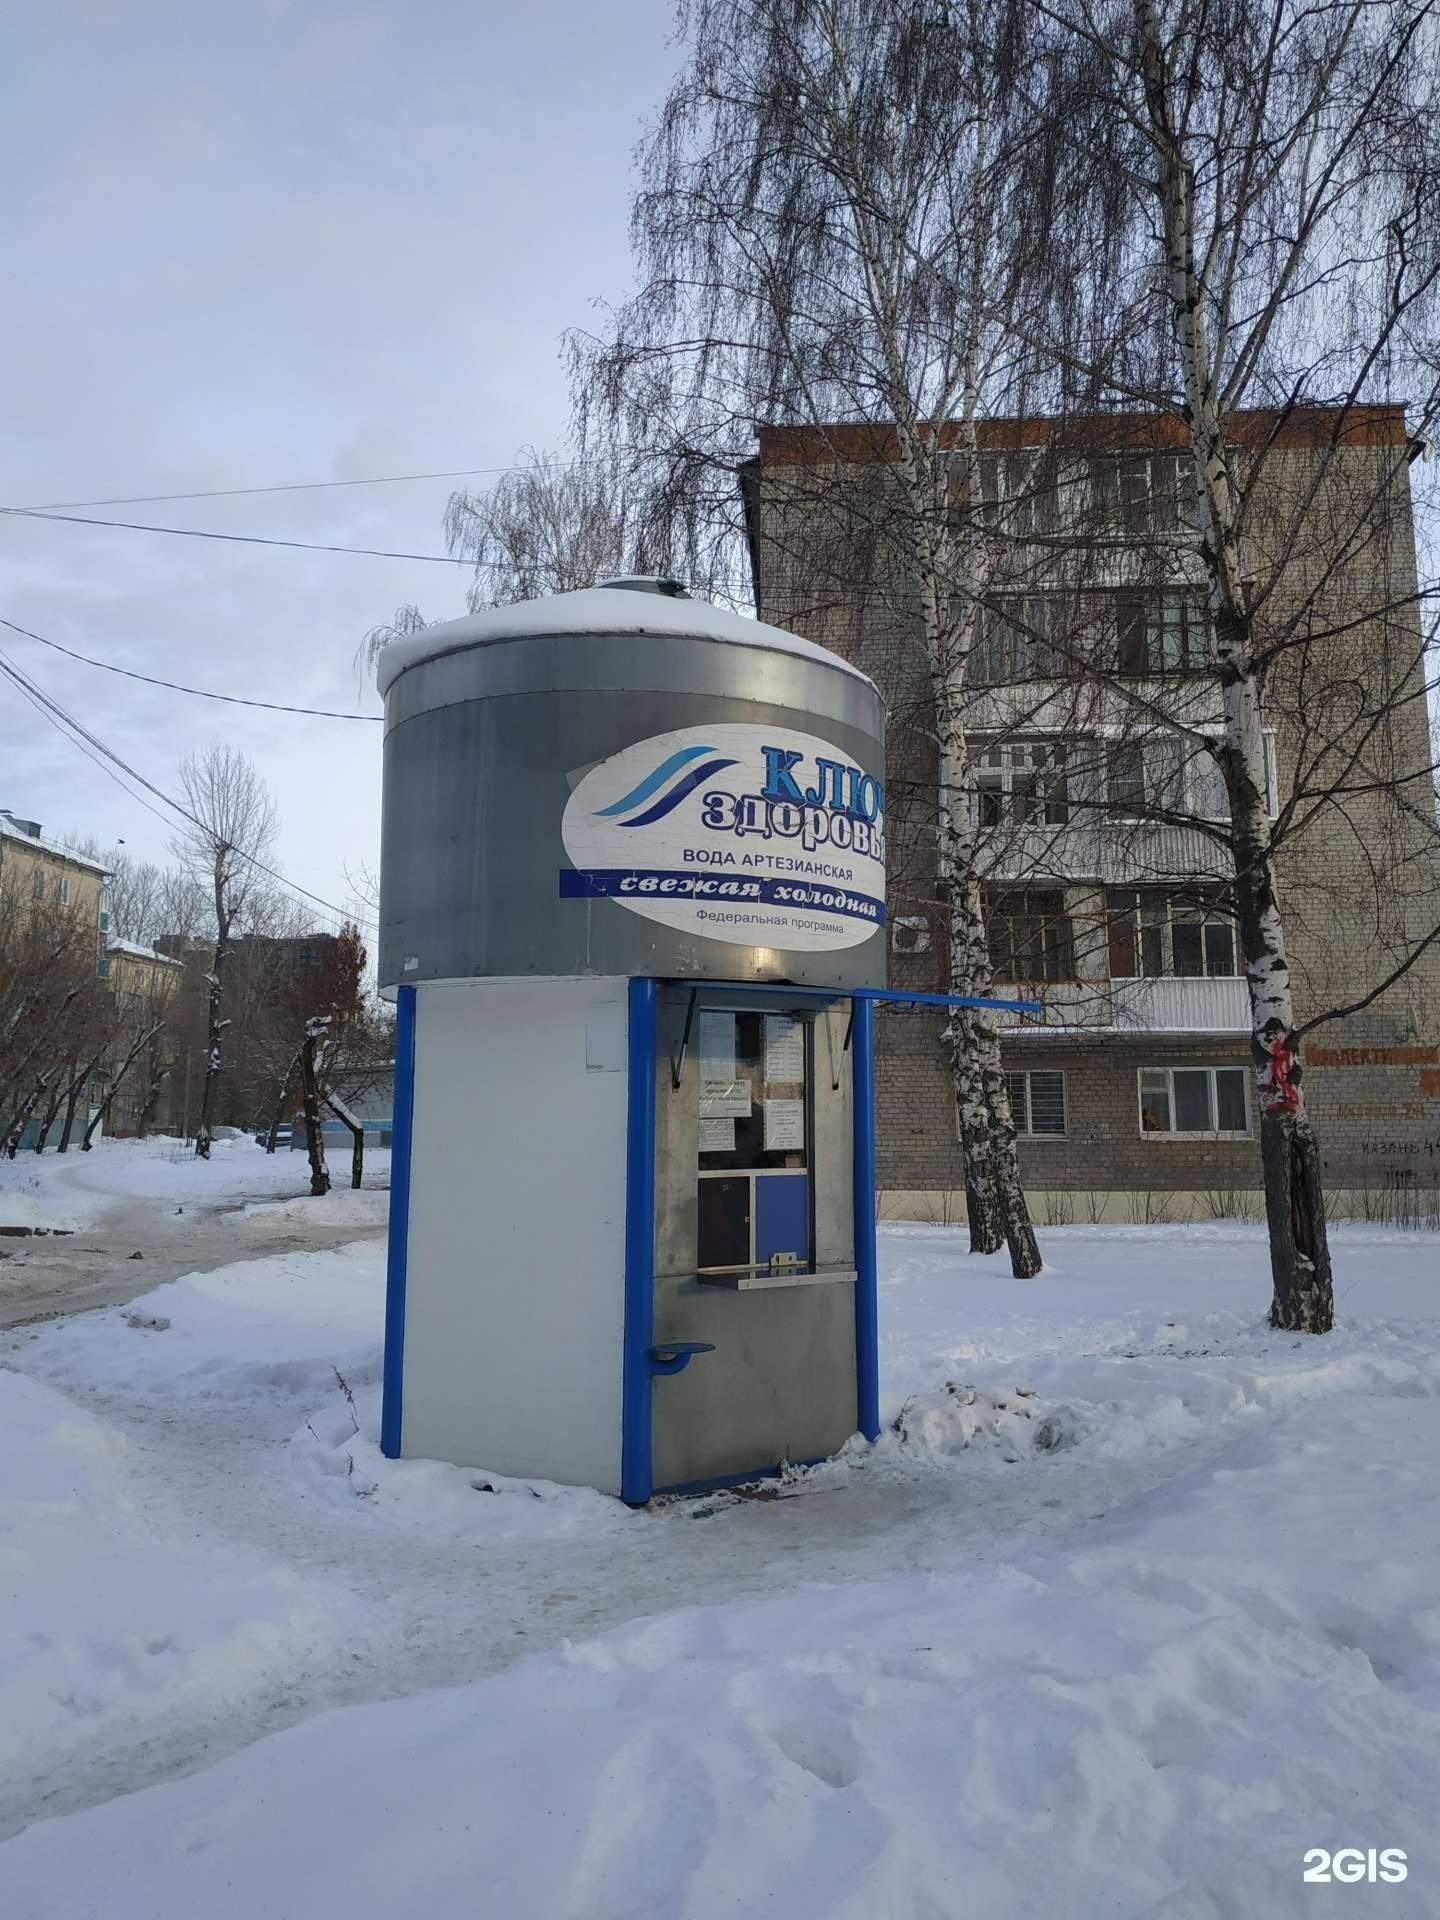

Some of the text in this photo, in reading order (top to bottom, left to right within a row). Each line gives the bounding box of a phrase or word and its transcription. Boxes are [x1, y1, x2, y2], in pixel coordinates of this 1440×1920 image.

[683, 849, 853, 881] ВОДА АРТЕЗИАНСКАЯ
[620, 876, 877, 917] свежая холодная
[696, 910, 845, 934] Федеральная программа
